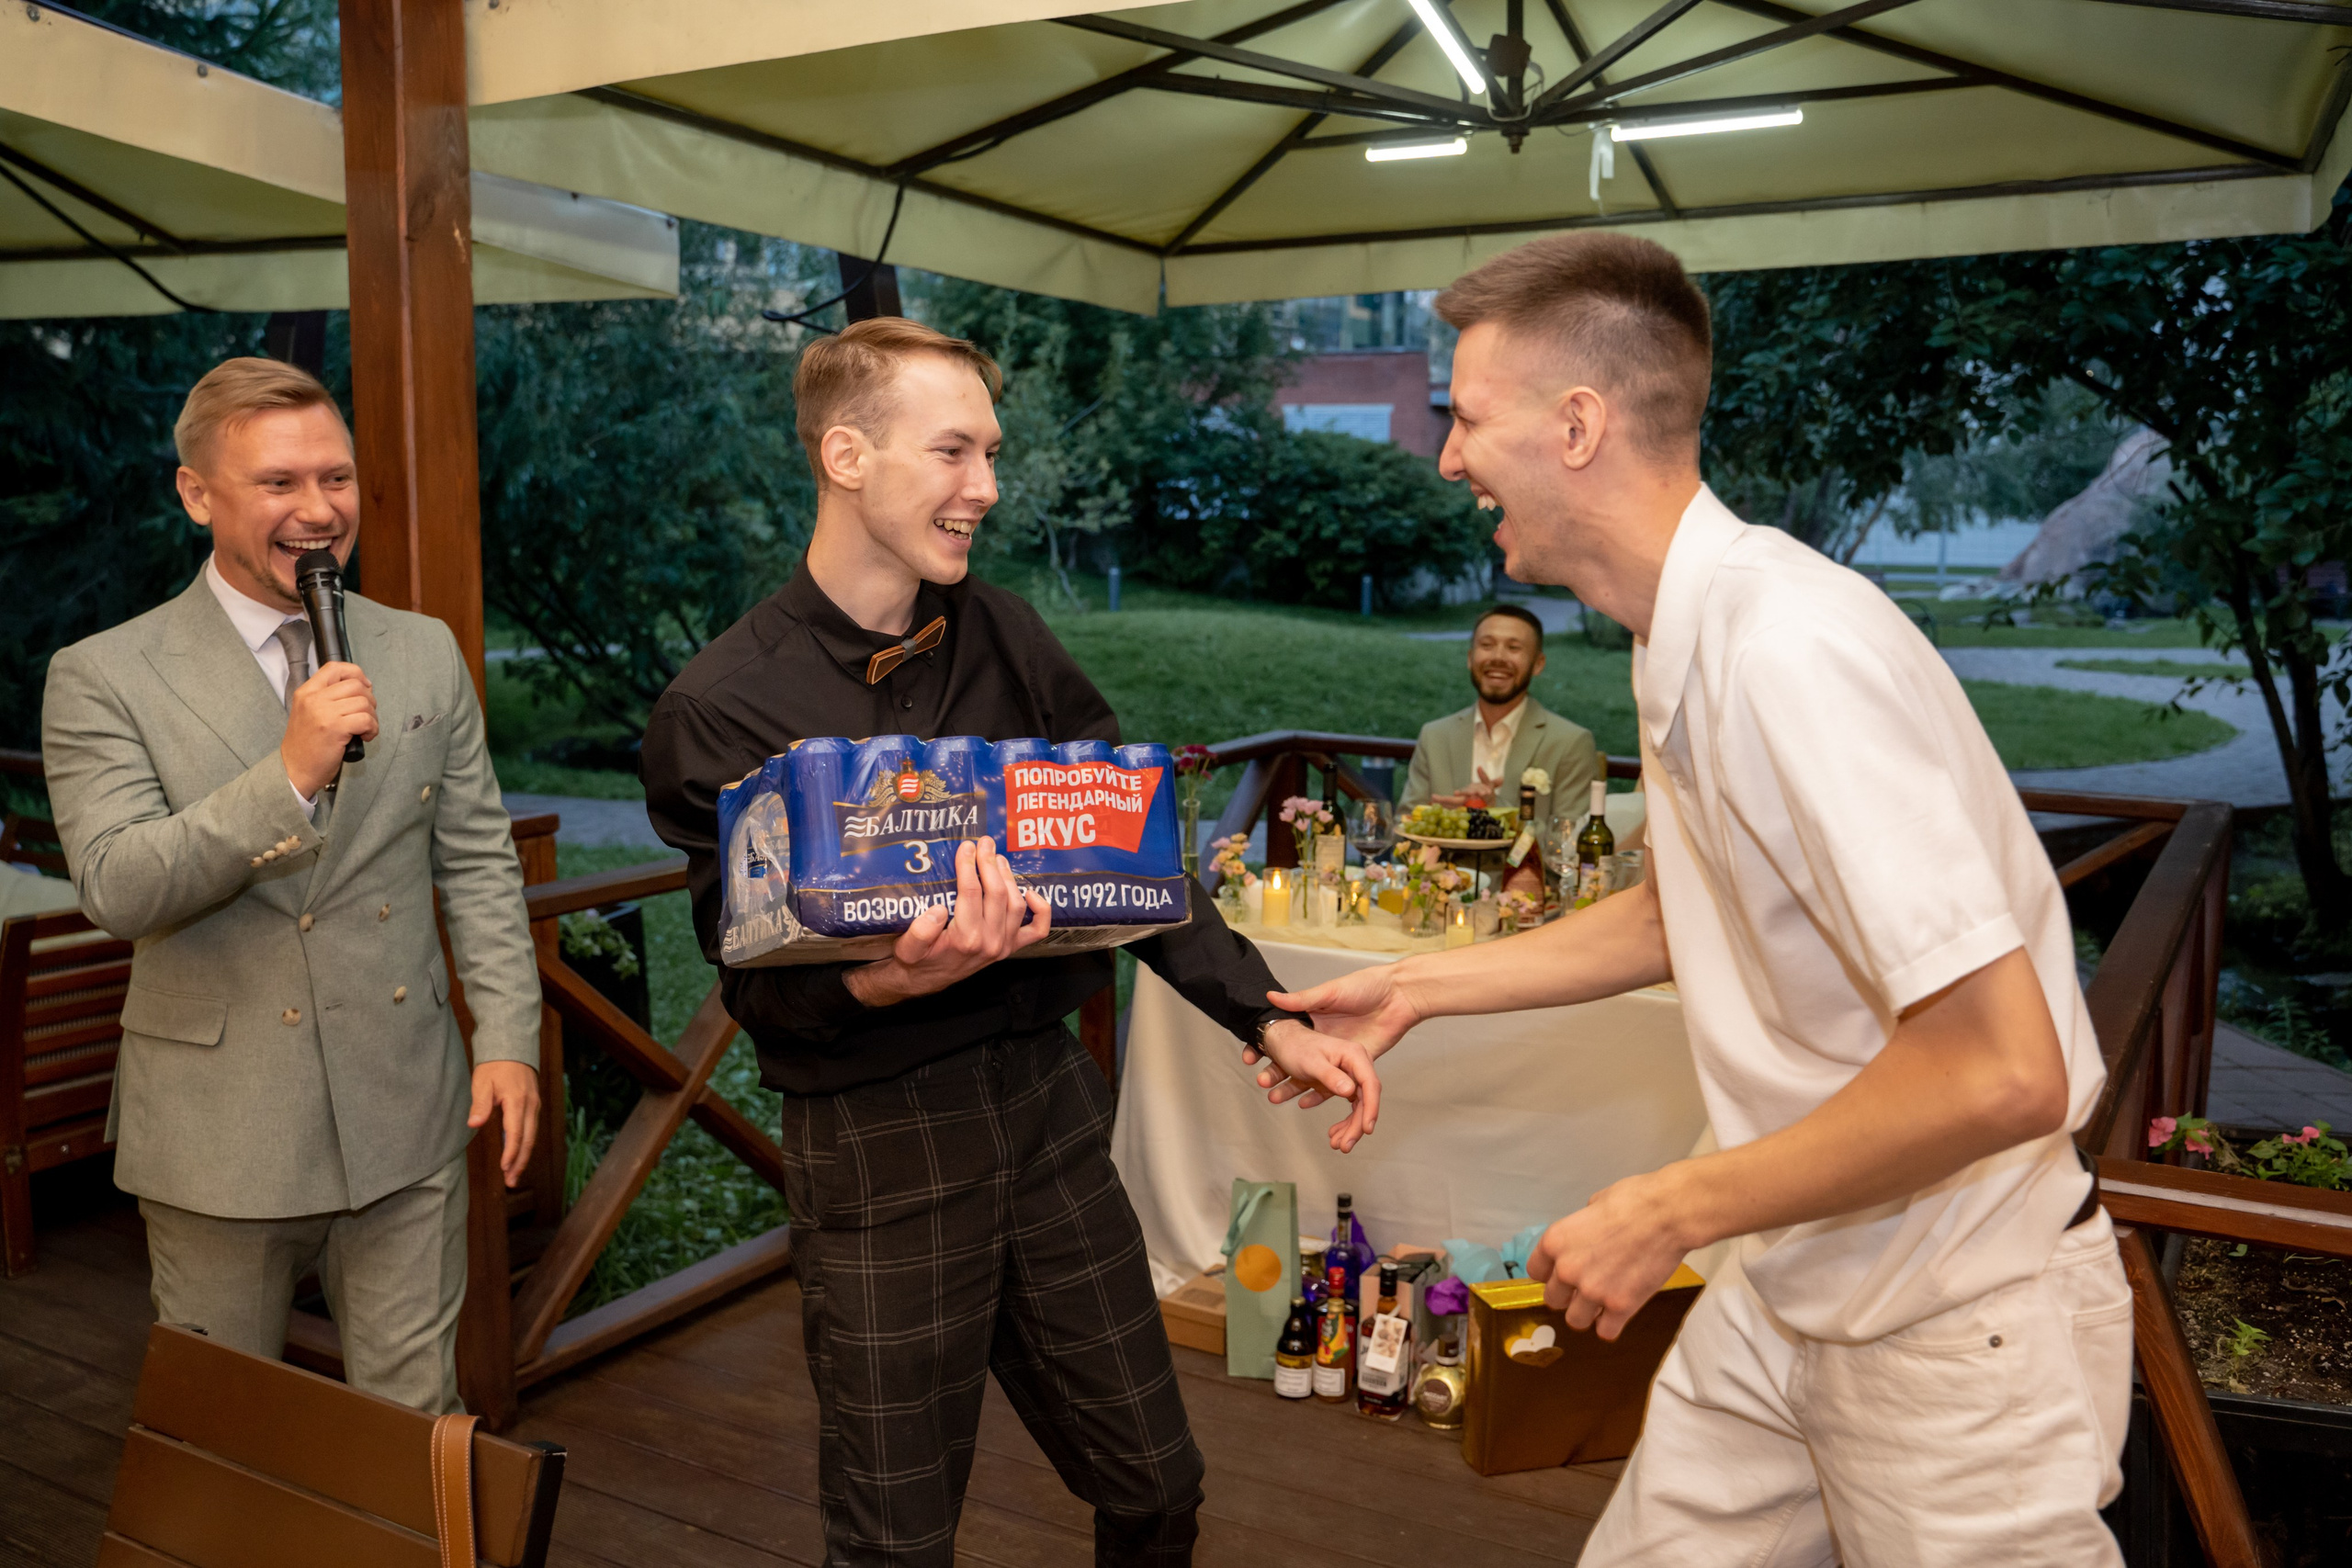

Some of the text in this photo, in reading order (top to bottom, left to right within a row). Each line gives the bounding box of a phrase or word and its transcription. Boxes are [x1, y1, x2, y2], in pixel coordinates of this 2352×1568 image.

[1015, 764, 1142, 791] ПОПРОБУЙТЕ
[1016, 789, 1143, 813] ЛЕГЕНДАРНЫЙ
[863, 805, 978, 838] БАЛТИКА
[1017, 813, 1096, 848] ВКУС
[903, 840, 932, 874] 3
[843, 891, 957, 922] ВОЗРОЖДЕ
[1072, 882, 1118, 908] 1992
[1121, 884, 1173, 910] ГОДА
